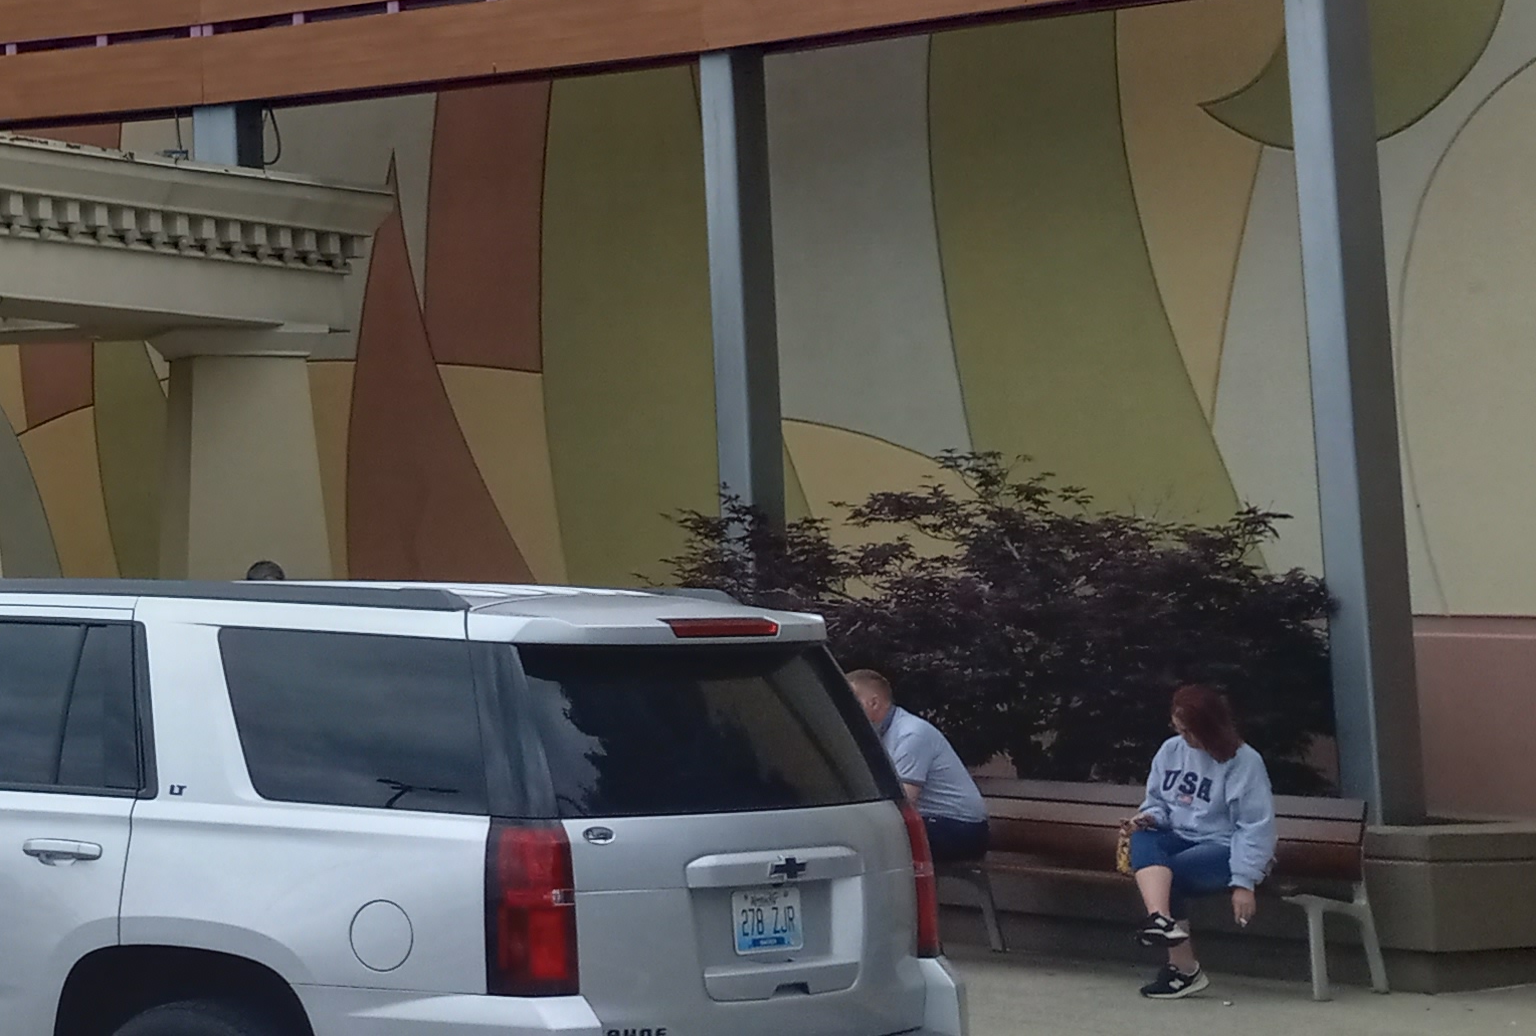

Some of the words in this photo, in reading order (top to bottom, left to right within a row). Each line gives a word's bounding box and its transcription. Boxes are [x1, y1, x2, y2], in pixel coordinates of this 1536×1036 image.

[169, 784, 187, 796] LT
[1162, 769, 1213, 803] USA
[740, 907, 765, 937] 278
[771, 905, 795, 935] ZJR
